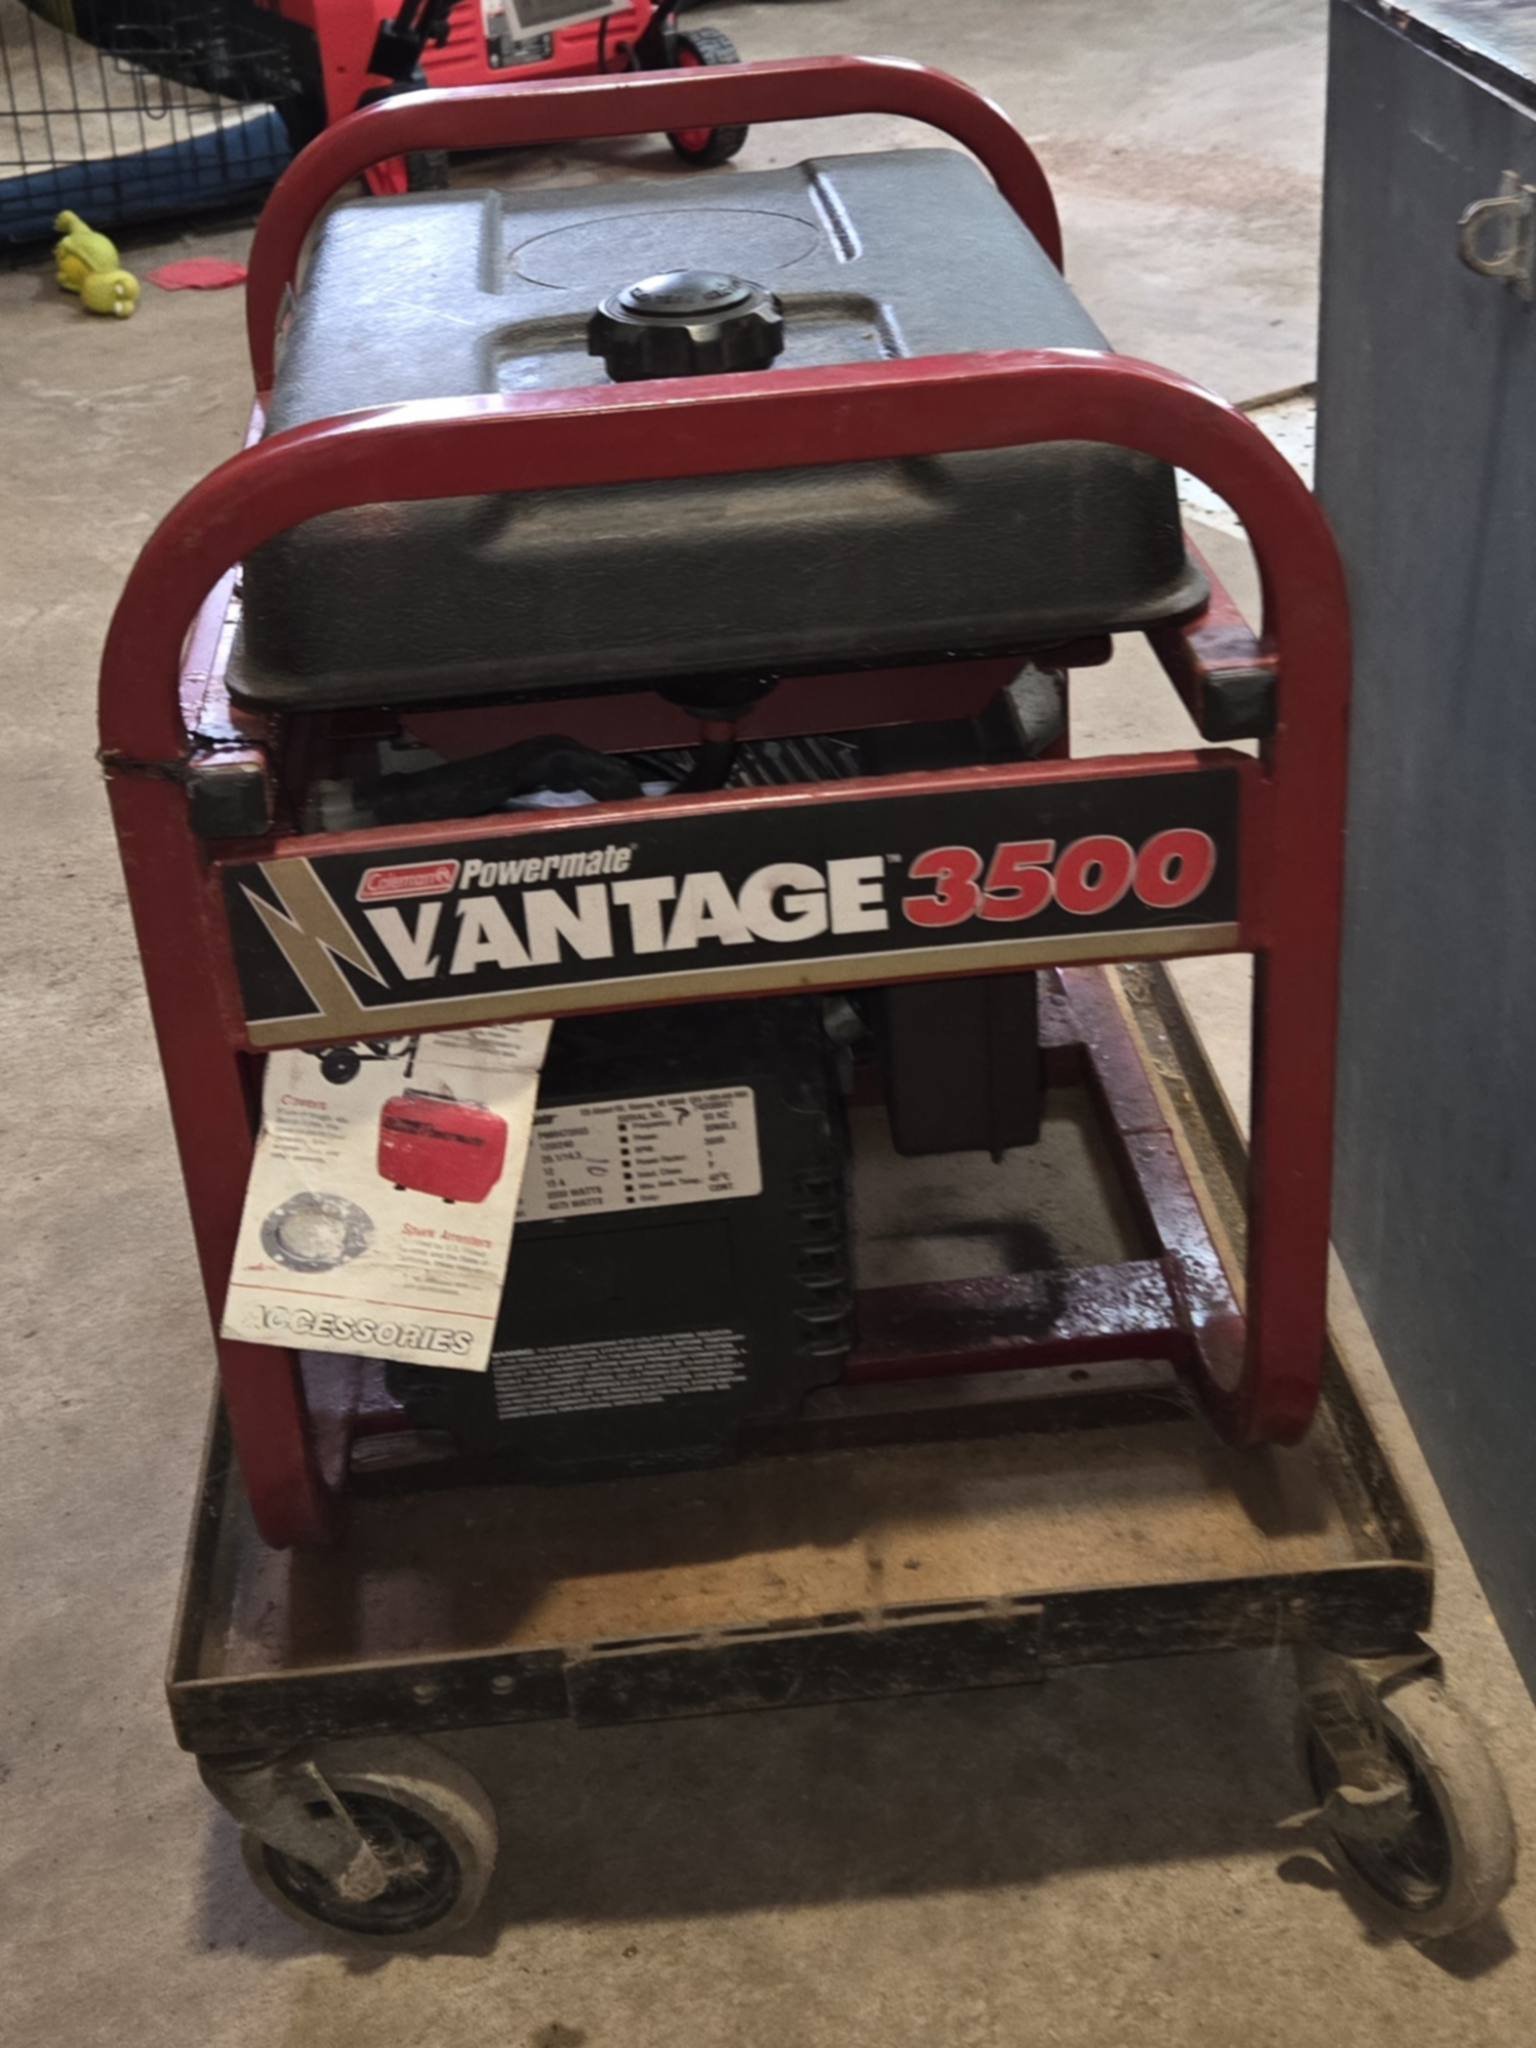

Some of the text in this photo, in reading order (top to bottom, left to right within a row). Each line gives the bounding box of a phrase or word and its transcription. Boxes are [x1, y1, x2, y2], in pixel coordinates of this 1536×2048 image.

[363, 828, 1216, 981] VANTAGE 3500
[459, 844, 633, 890] Powermate
